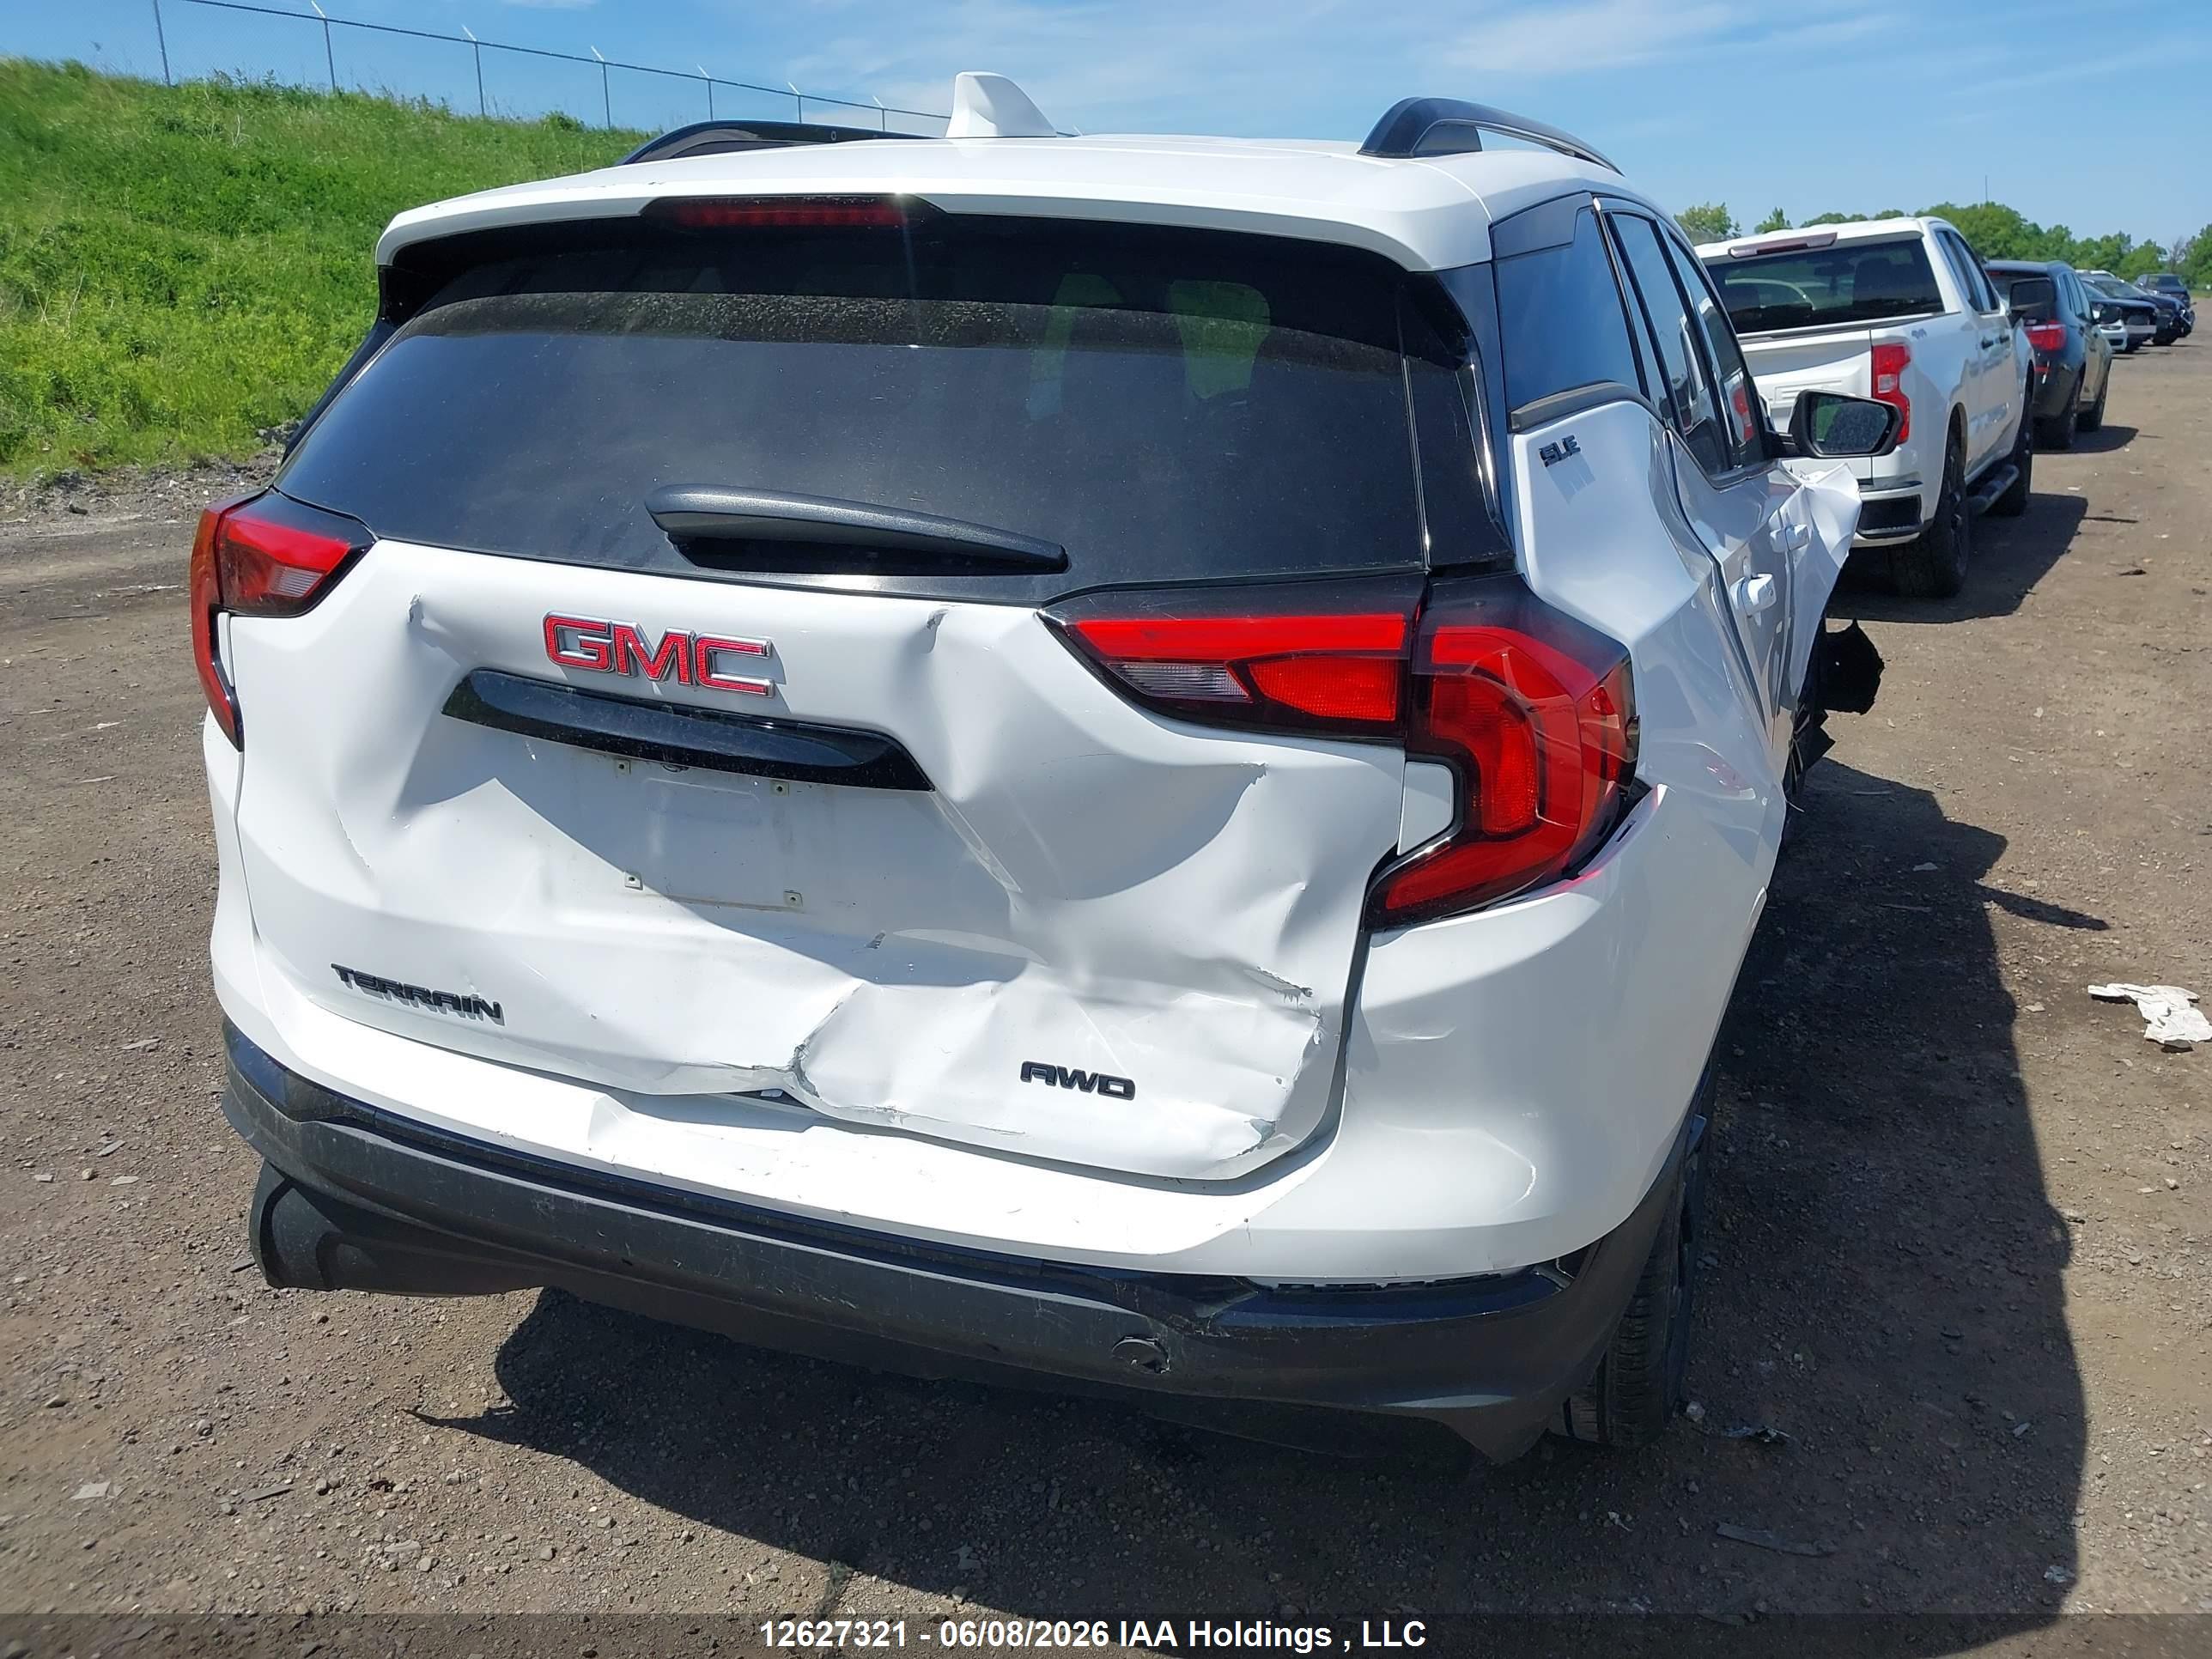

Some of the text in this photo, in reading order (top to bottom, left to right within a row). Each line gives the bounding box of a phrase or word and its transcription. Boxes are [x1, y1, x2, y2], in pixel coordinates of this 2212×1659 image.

[1539, 434, 1581, 467] SLE
[543, 611, 775, 697] GMC
[331, 963, 502, 1020] TERRAIN
[1020, 1060, 1136, 1101] AWD
